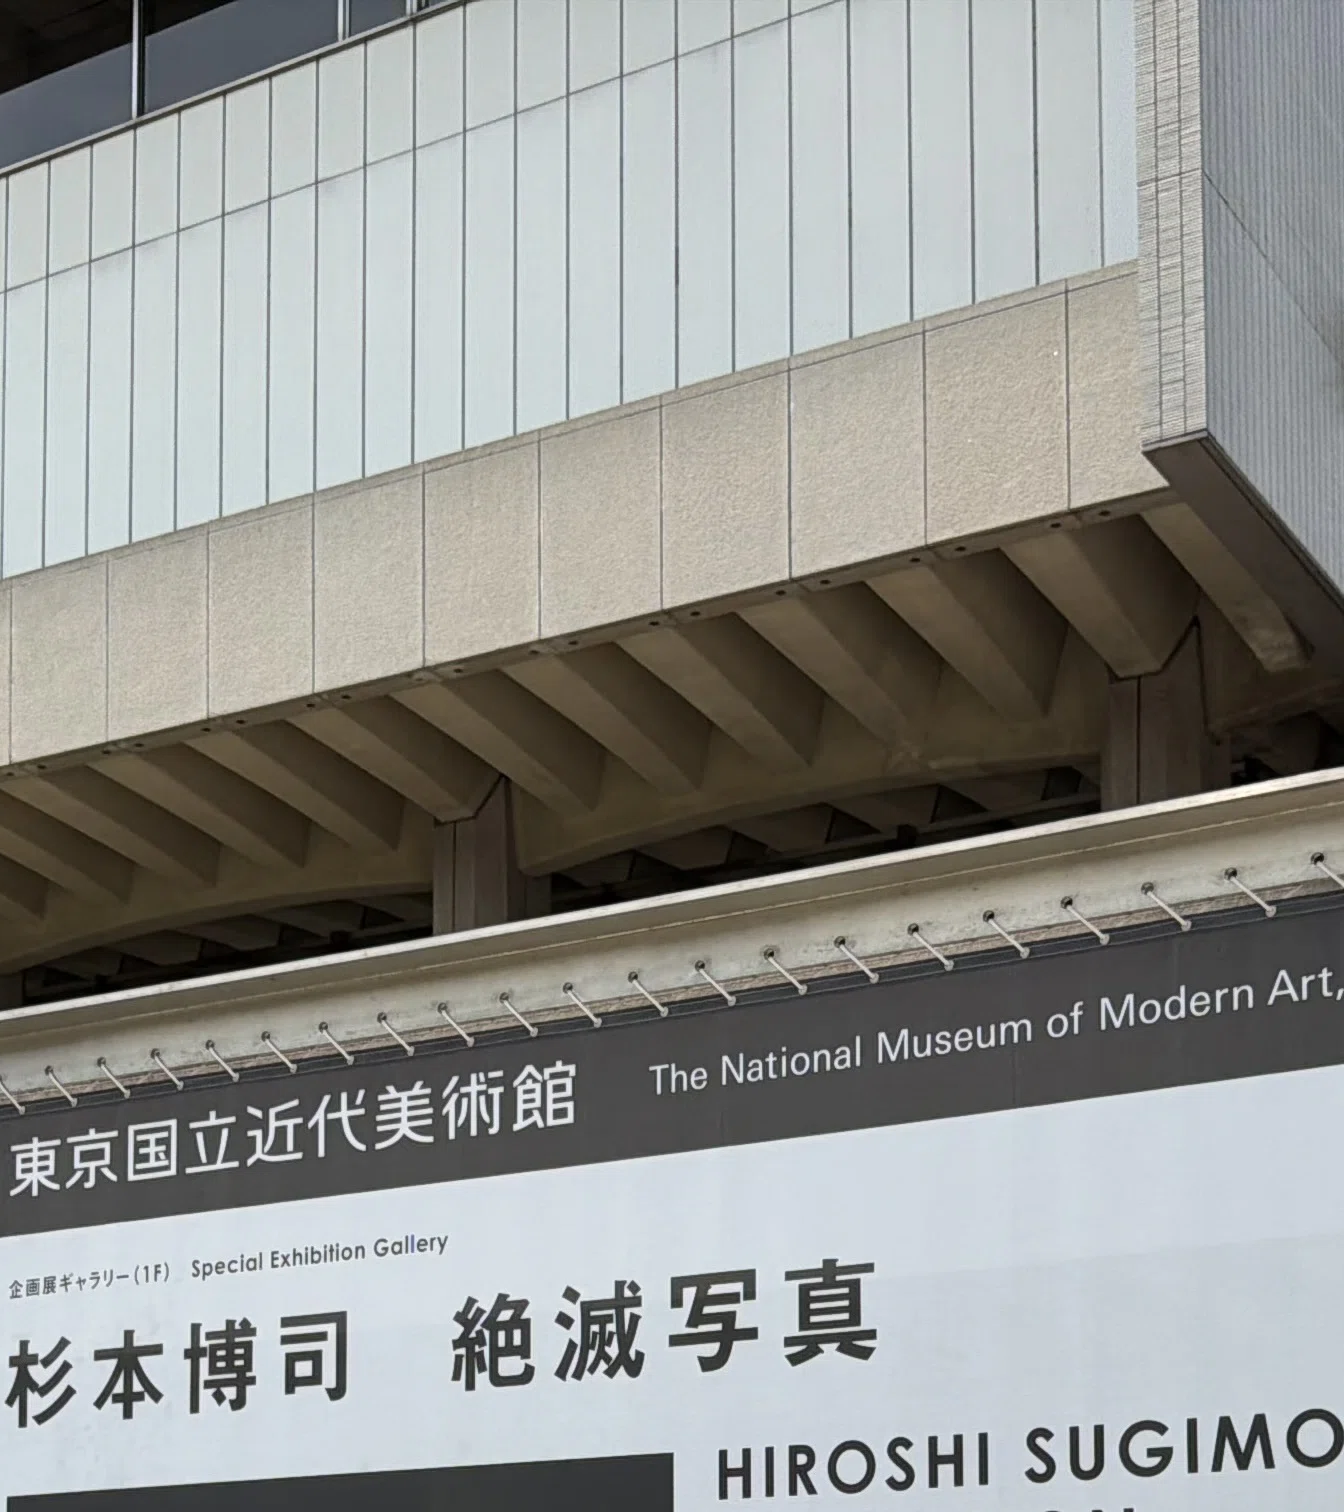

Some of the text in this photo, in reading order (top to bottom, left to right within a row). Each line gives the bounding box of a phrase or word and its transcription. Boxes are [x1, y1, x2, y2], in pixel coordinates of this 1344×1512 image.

[648, 1062, 708, 1095] The
[721, 1035, 861, 1086] National
[877, 1018, 1032, 1064] Museum
[1046, 1000, 1084, 1038] of
[1100, 984, 1254, 1031] Modern
[1267, 967, 1344, 1006] Art,
[9, 1059, 577, 1197] 東京国立近代美術館
[191, 1251, 263, 1282] Special
[270, 1242, 366, 1269] Exhibition
[373, 1234, 449, 1258] Gallery
[4, 1258, 878, 1429] 杉本博司 絶滅写真
[718, 1431, 989, 1501] HIROSHI
